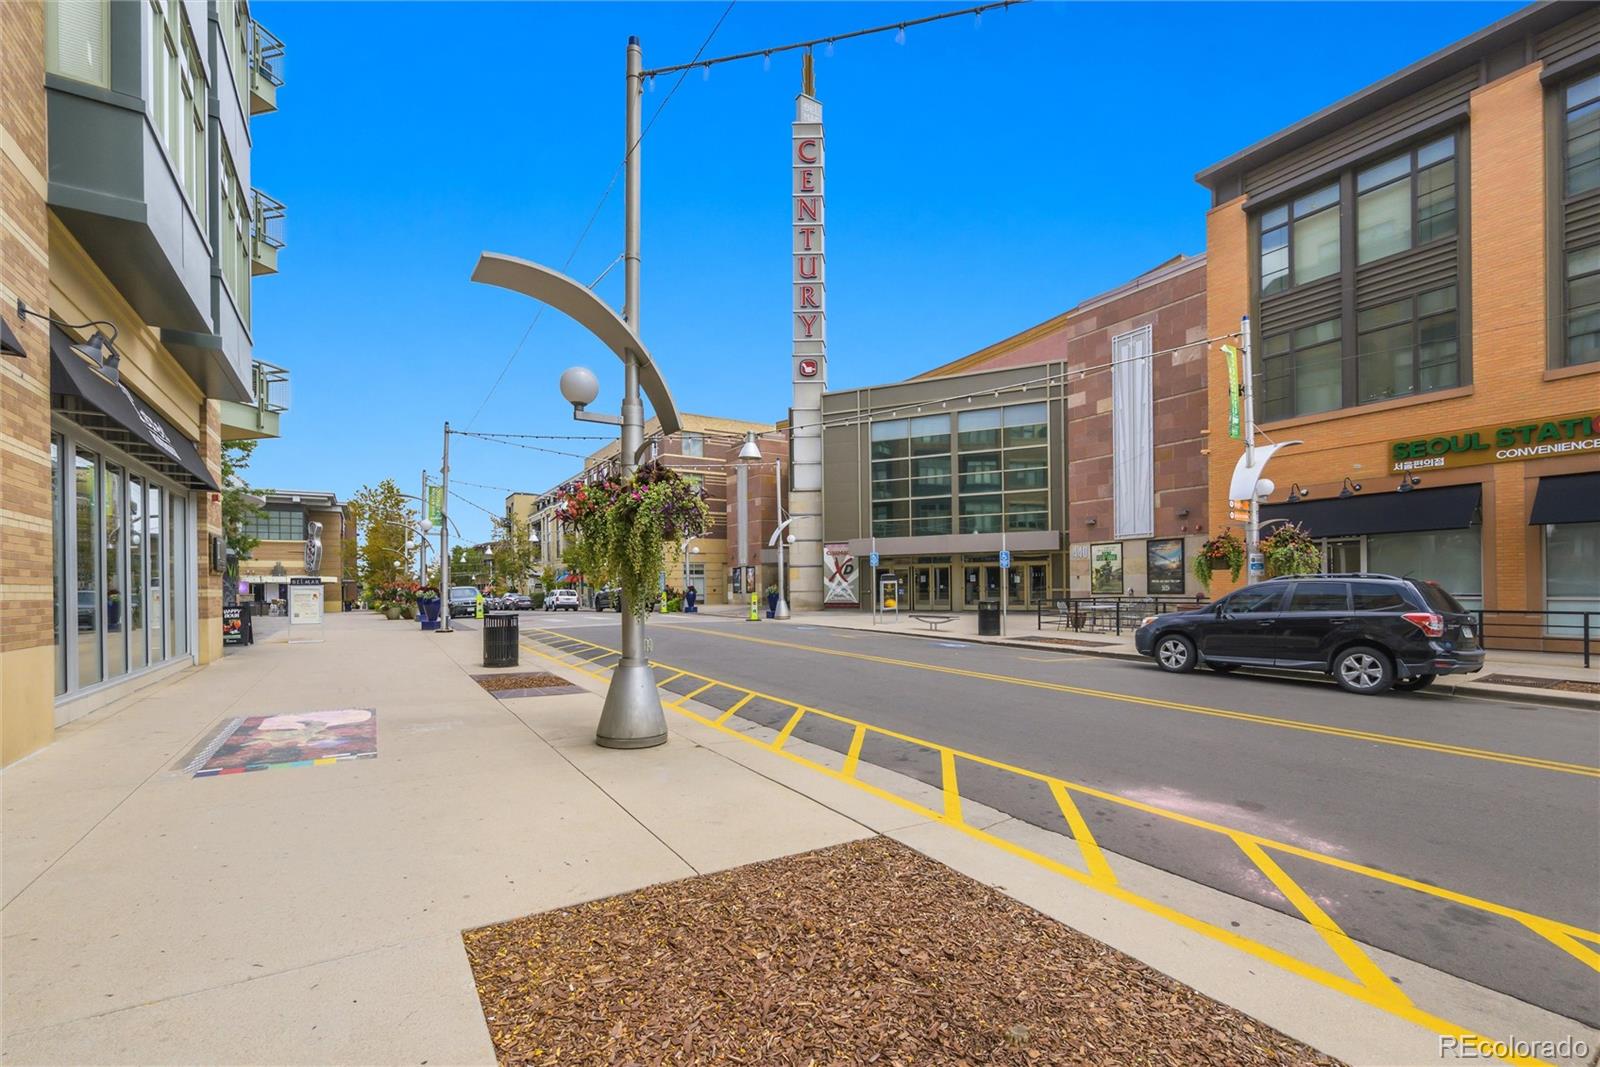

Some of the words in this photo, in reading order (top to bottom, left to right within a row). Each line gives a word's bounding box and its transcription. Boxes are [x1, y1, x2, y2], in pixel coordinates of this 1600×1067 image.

[798, 139, 819, 337] CENTURY
[1392, 431, 1490, 461] SEOUL
[1496, 439, 1600, 459] CONVENIENCE
[1393, 457, 1445, 471] 서울편의점
[828, 556, 854, 583] XD
